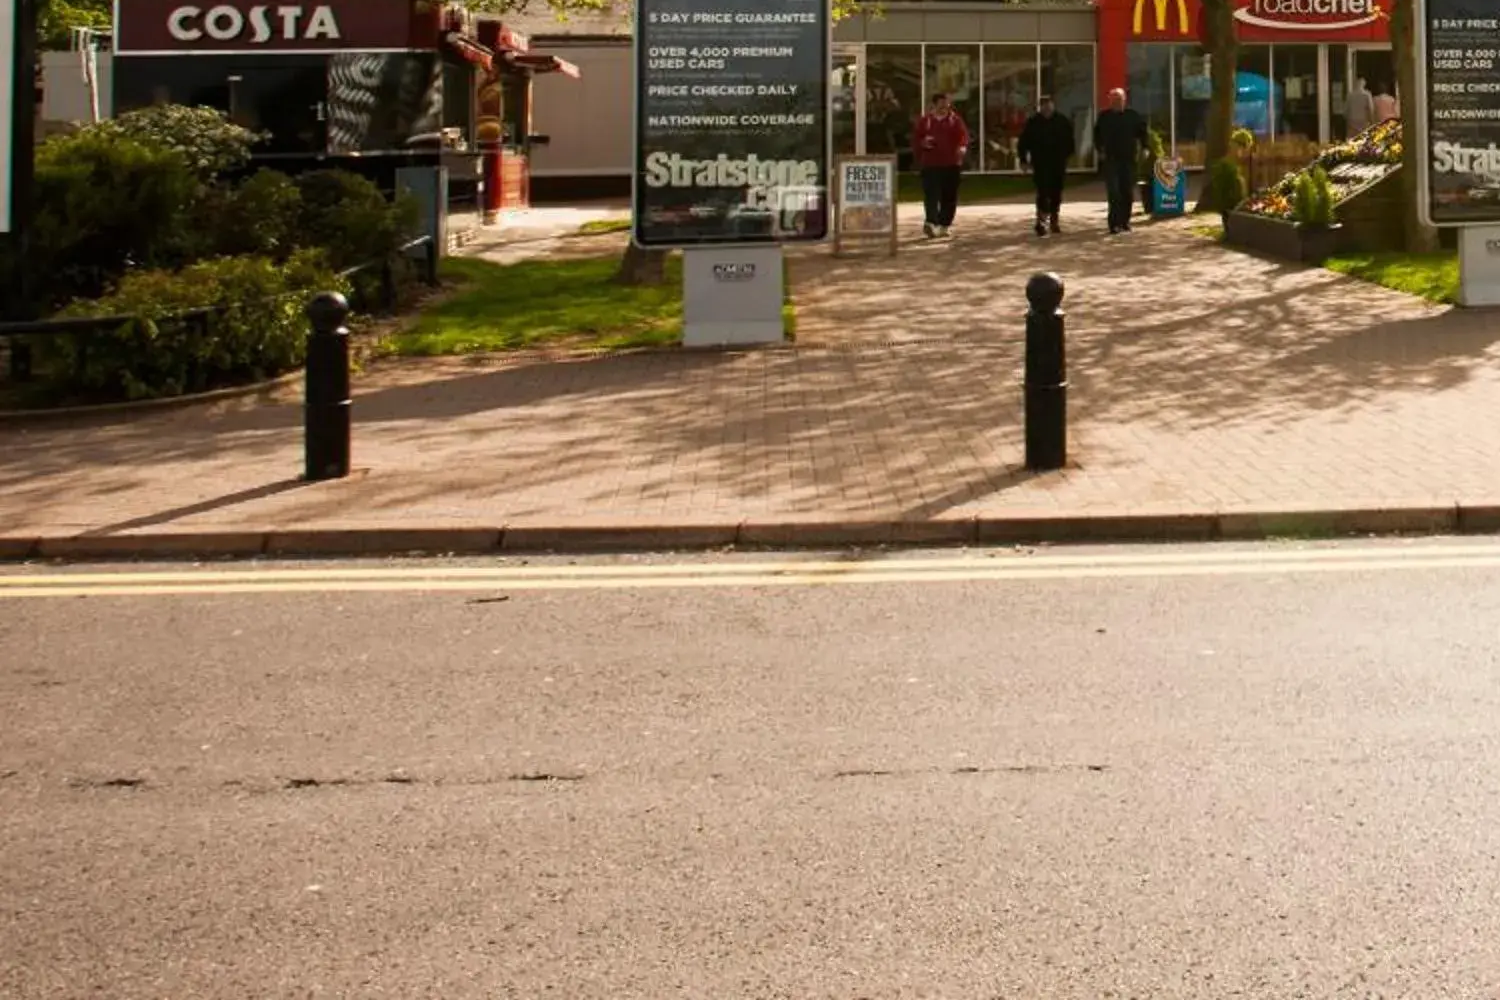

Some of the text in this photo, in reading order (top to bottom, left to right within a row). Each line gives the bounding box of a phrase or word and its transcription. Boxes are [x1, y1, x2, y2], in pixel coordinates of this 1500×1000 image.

[661, 13, 690, 23] DAY
[693, 13, 732, 23] PRICE
[735, 12, 817, 23] GUARANTEE
[166, 4, 341, 43] COSTA
[1442, 19, 1464, 29] DAY
[1466, 19, 1498, 29] PRICE
[649, 46, 793, 58] OVER 4,000 PREMIUM
[1433, 49, 1463, 59] OVER
[649, 59, 725, 69] USED CARS
[1433, 59, 1493, 69] USED CARS
[648, 84, 798, 96] PRICE CHECKED DAILY
[1433, 83, 1465, 93] PRICE
[649, 114, 815, 126] NATIONWIDE COVERAGE
[645, 151, 818, 188] Stratstone
